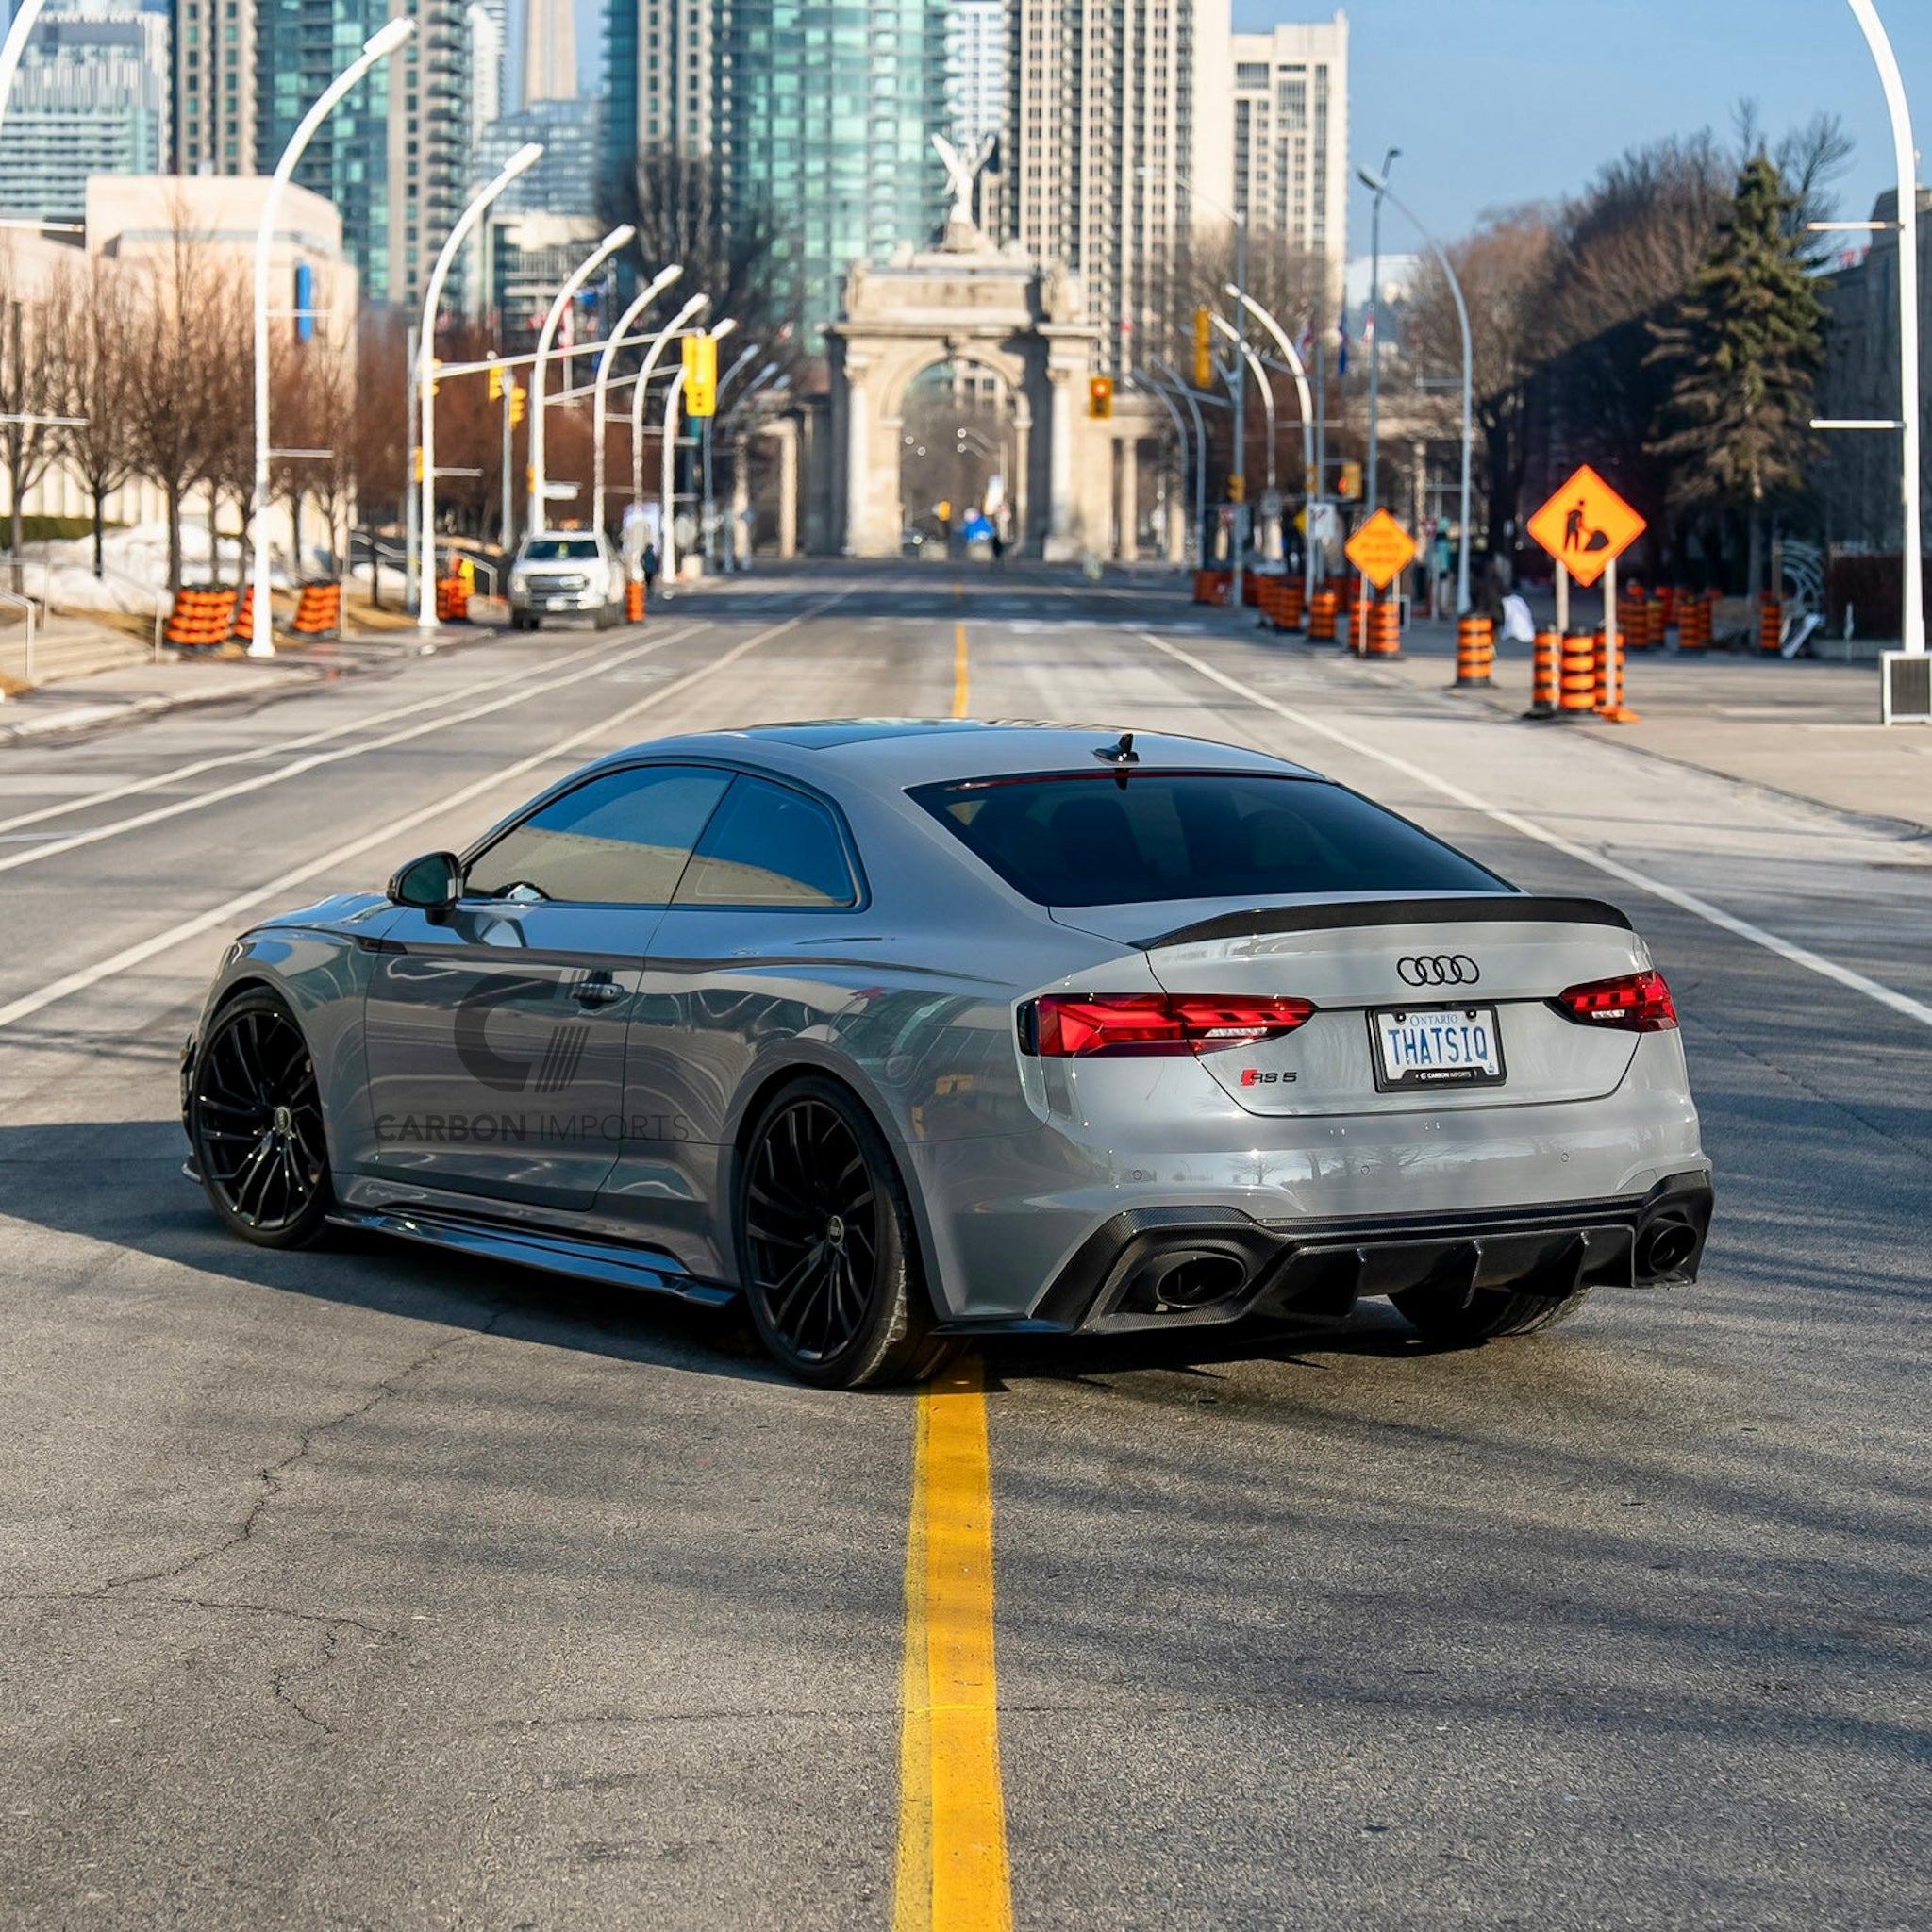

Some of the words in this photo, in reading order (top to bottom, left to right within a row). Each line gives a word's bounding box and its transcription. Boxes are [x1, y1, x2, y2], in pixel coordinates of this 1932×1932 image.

[1409, 1014, 1458, 1027] ONTARIO
[1388, 1026, 1488, 1066] THATSIQ
[1282, 1072, 1297, 1083] 5
